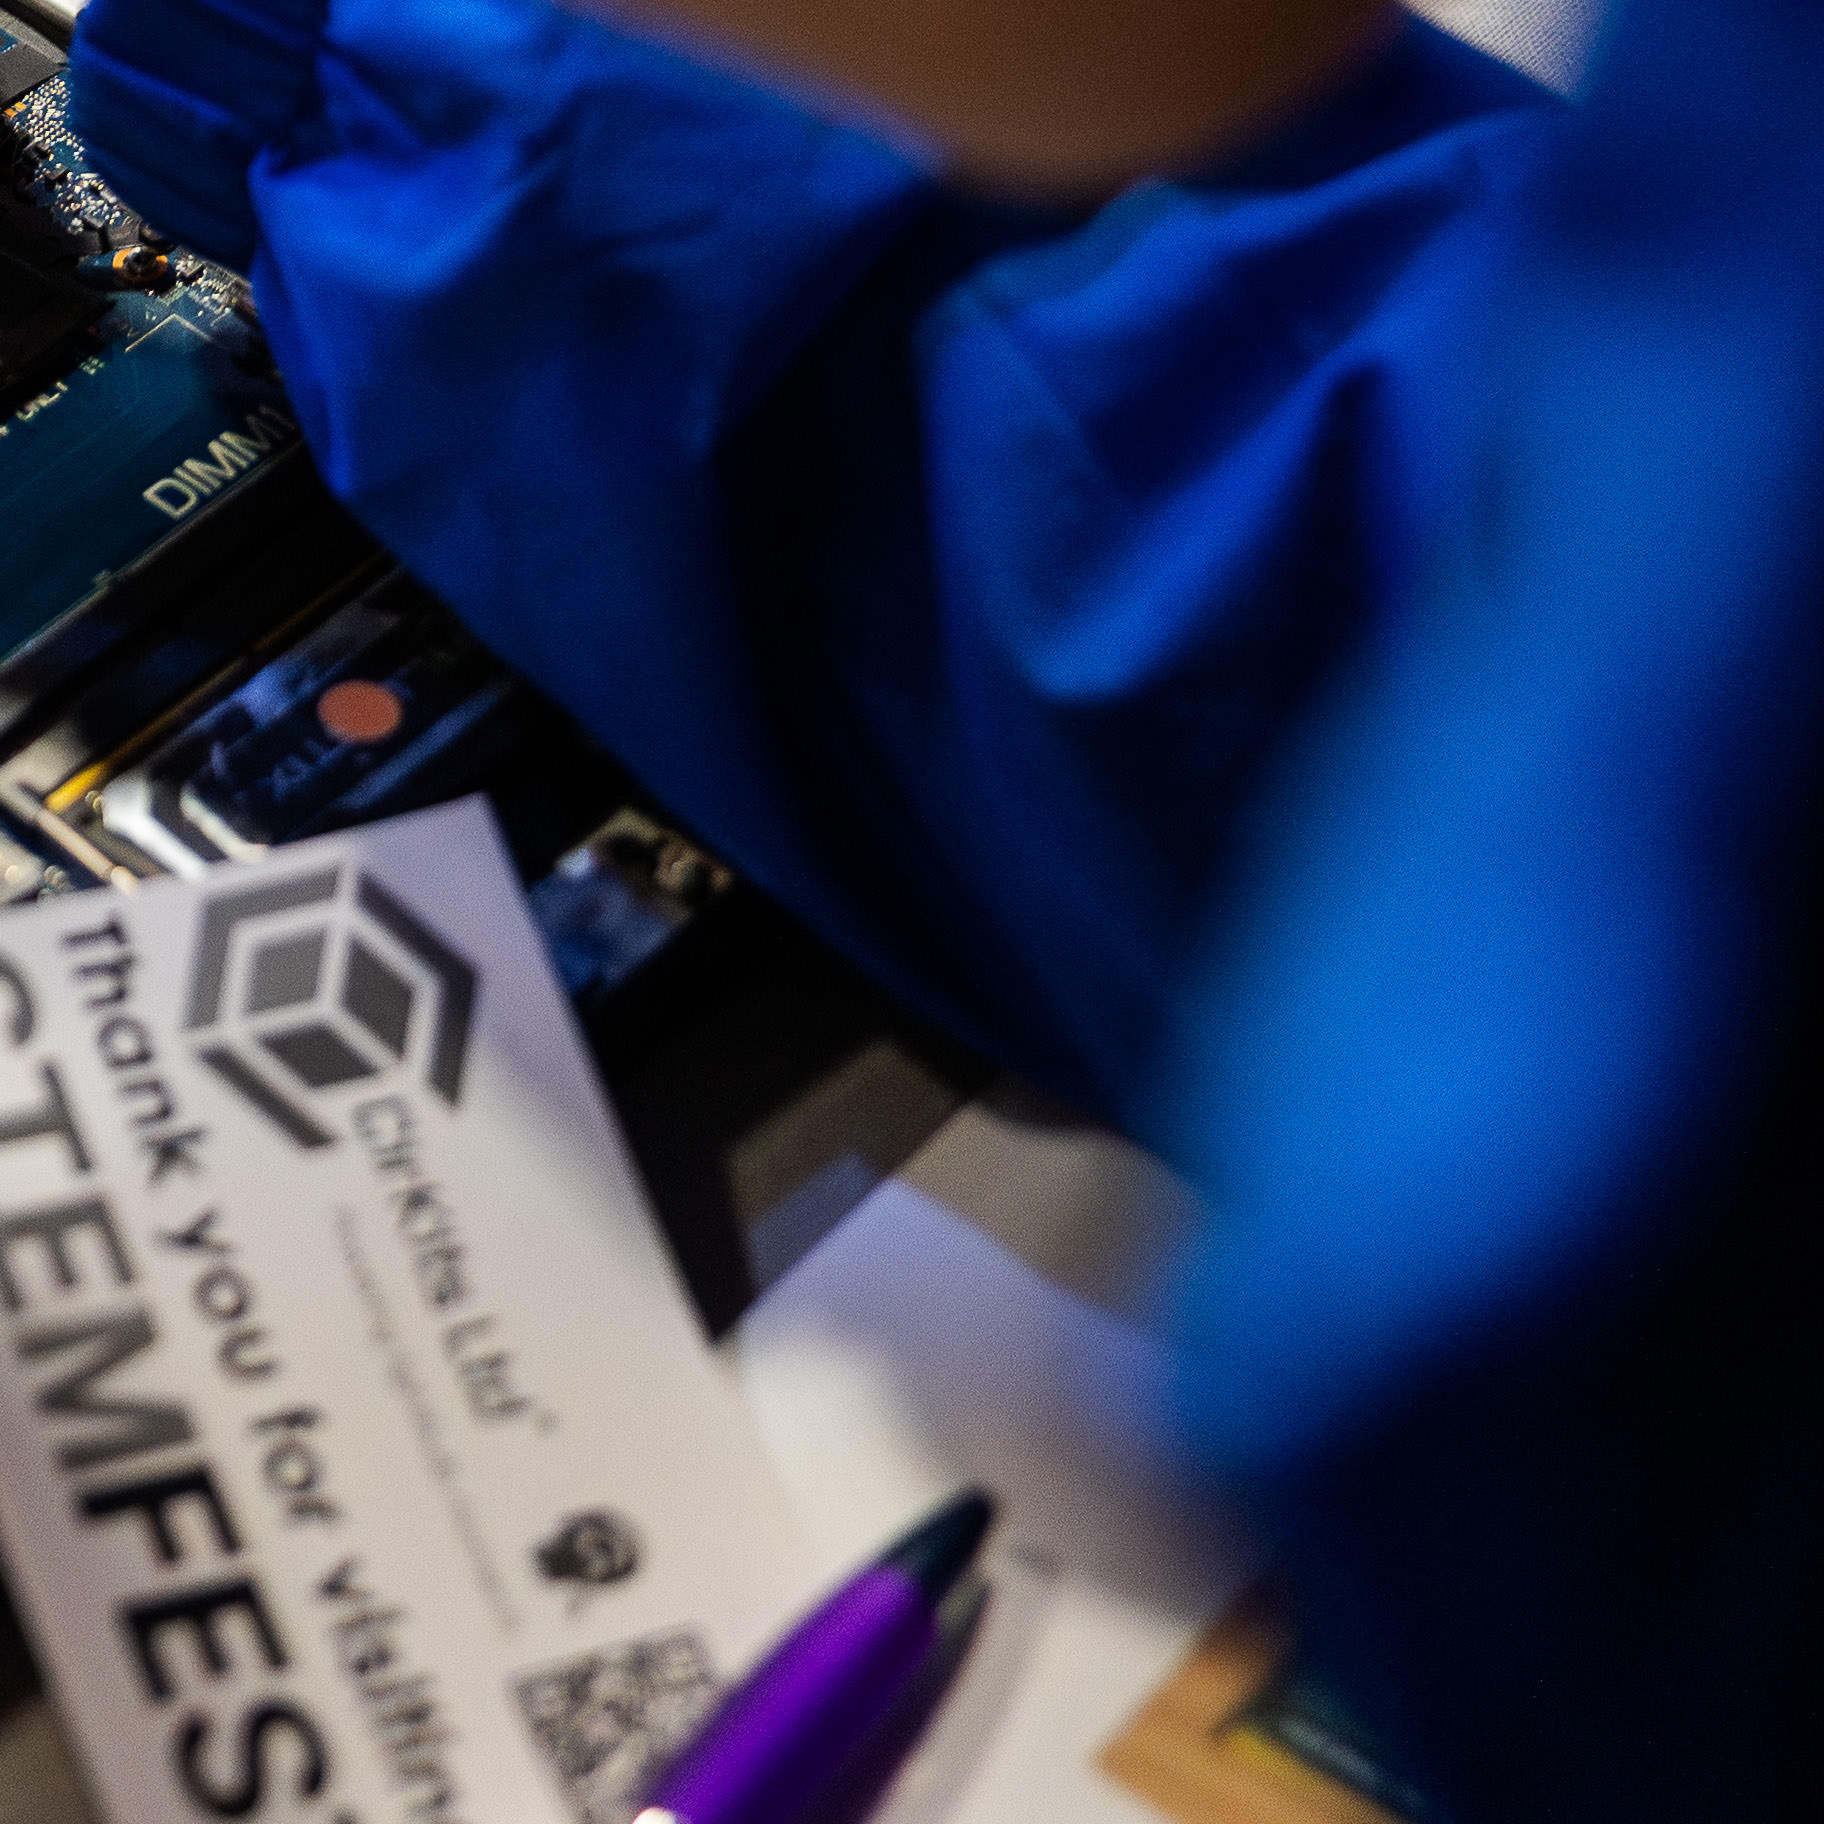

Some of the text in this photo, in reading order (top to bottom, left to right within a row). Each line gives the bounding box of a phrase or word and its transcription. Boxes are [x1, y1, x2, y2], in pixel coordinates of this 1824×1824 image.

[59, 913, 209, 1183] Thank
[156, 1204, 281, 1383] you
[251, 1403, 345, 1526] for
[313, 1551, 472, 1824] visitin
[352, 1092, 469, 1311] CirKits
